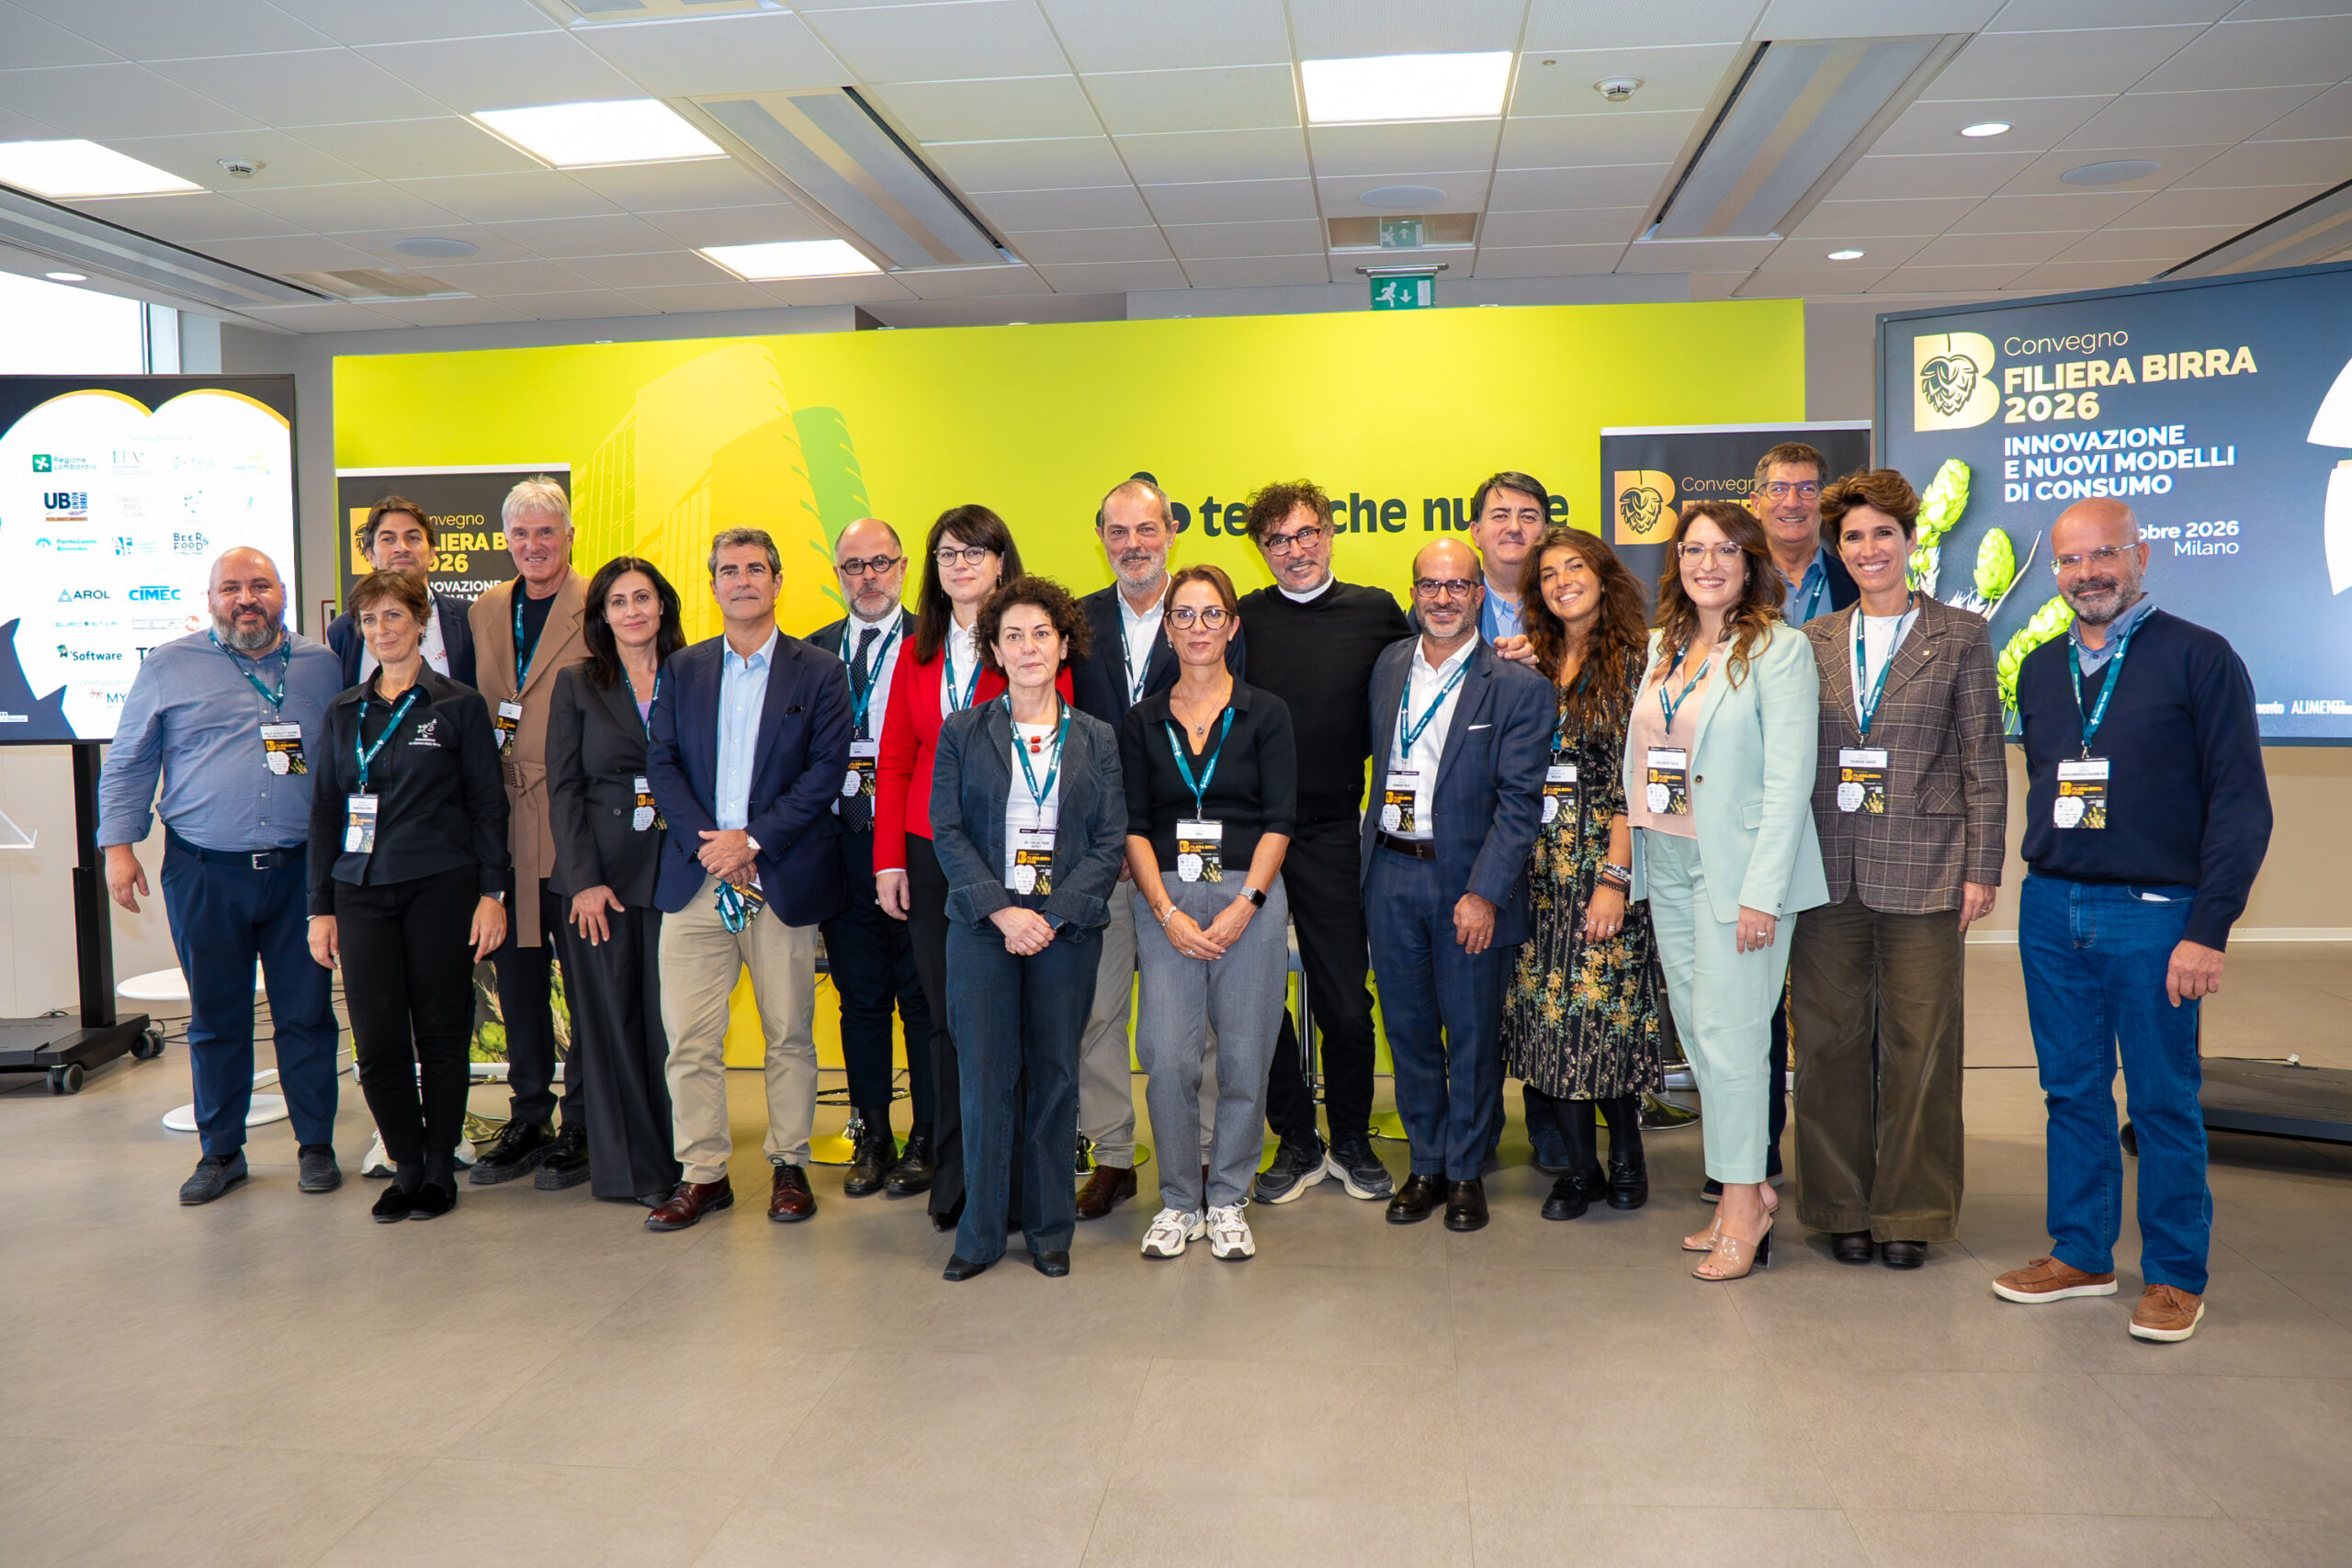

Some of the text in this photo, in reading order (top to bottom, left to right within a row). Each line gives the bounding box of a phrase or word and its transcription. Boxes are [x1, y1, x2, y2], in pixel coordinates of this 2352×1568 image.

[2004, 330, 2129, 356] Convegno
[2004, 345, 2258, 395] FILIERA BIRRA
[2004, 391, 2100, 424] 2026
[2004, 424, 2186, 457] INNOVAZIONE
[2004, 446, 2235, 479] E NUOVI MODELLI
[2004, 474, 2173, 502] DI CONSUMO
[44, 492, 71, 510] UB
[1199, 493, 1568, 537] teche nue
[174, 532, 202, 542] BEER
[2186, 520, 2239, 538] 2026
[174, 542, 204, 551] FOOD
[435, 532, 490, 552] IERA
[2174, 540, 2239, 557] Milano
[74, 590, 110, 600] AROL
[129, 588, 182, 602] CIMEC
